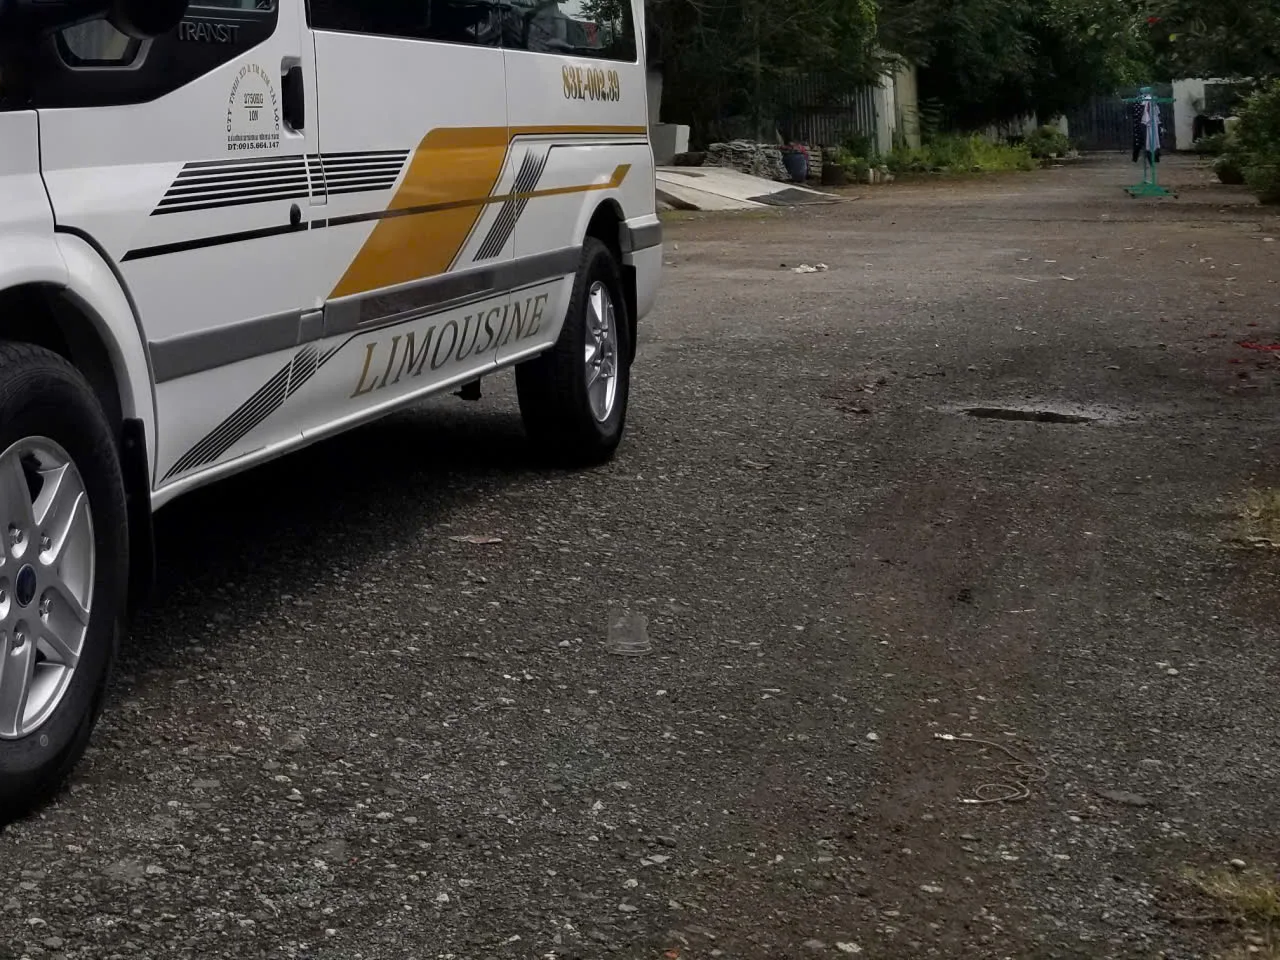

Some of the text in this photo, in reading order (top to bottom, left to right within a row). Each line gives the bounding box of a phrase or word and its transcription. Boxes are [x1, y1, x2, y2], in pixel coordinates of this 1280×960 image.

[178, 20, 240, 44] TRANSIT
[562, 64, 620, 103] 83E-002.39
[350, 293, 549, 399] LIMOUSINE
